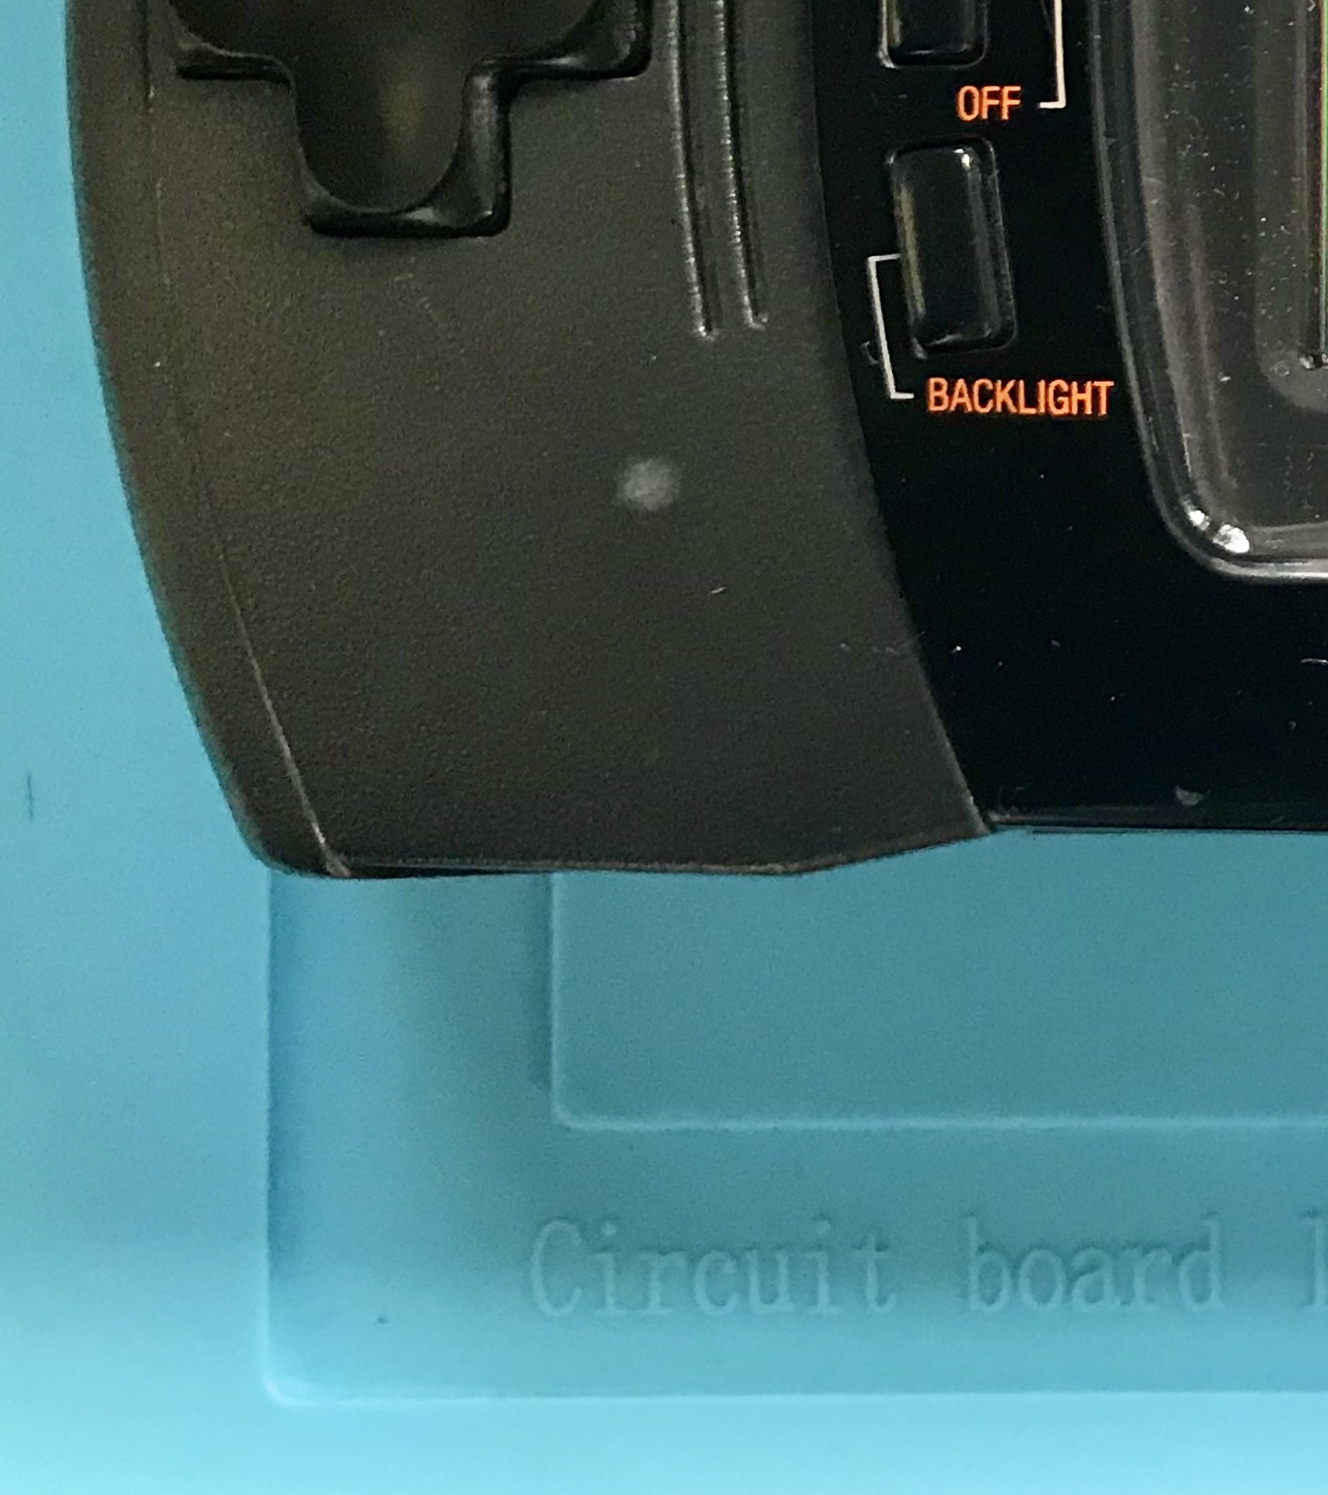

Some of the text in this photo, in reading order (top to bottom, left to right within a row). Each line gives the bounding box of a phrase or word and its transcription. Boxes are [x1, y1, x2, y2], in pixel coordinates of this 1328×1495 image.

[956, 85, 1021, 121] OFF
[926, 377, 1114, 416] BACKLIGHT
[529, 1216, 898, 1314] Circuit
[961, 1210, 1229, 1310] board
